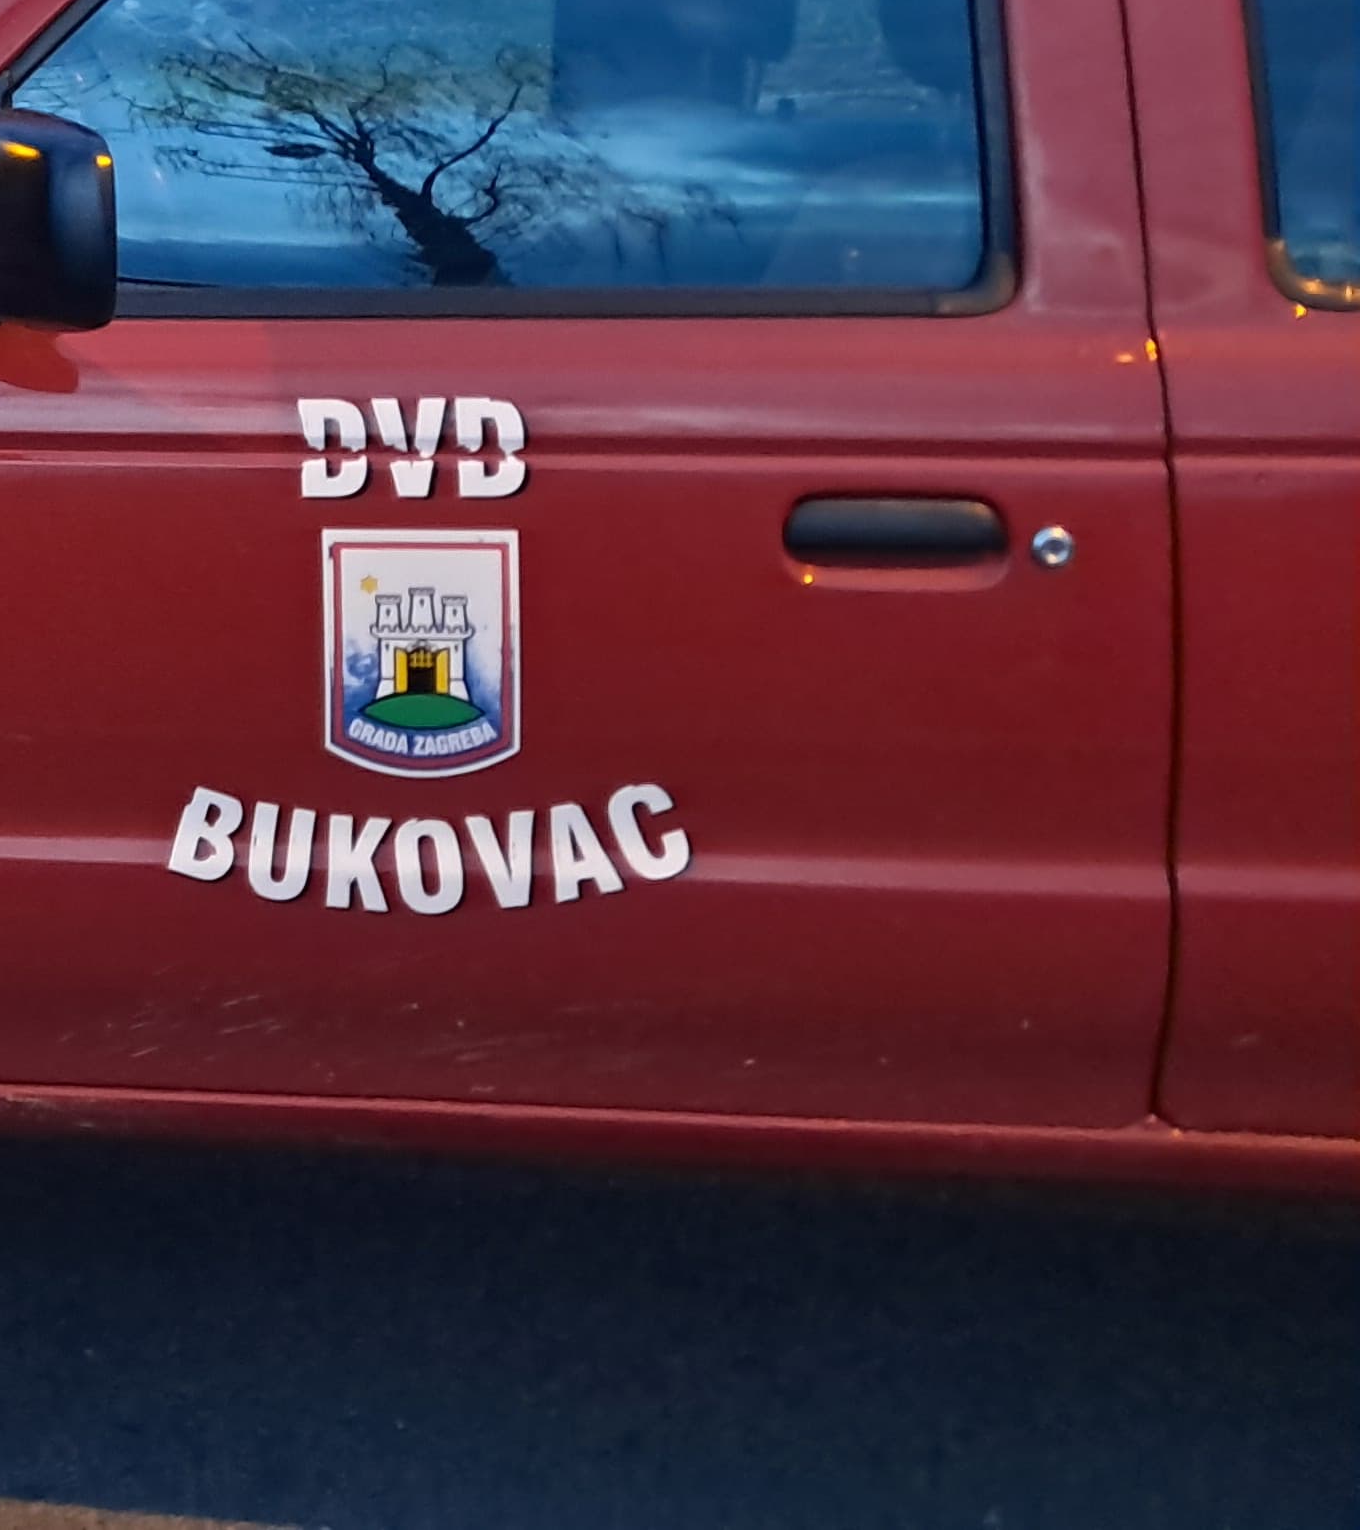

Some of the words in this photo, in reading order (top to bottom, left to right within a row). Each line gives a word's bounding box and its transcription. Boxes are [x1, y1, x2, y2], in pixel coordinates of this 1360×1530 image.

[297, 397, 526, 499] DVD
[348, 718, 409, 755] GRADA
[412, 721, 498, 757] ZAGREBA
[168, 783, 691, 916] BUKOVAC
